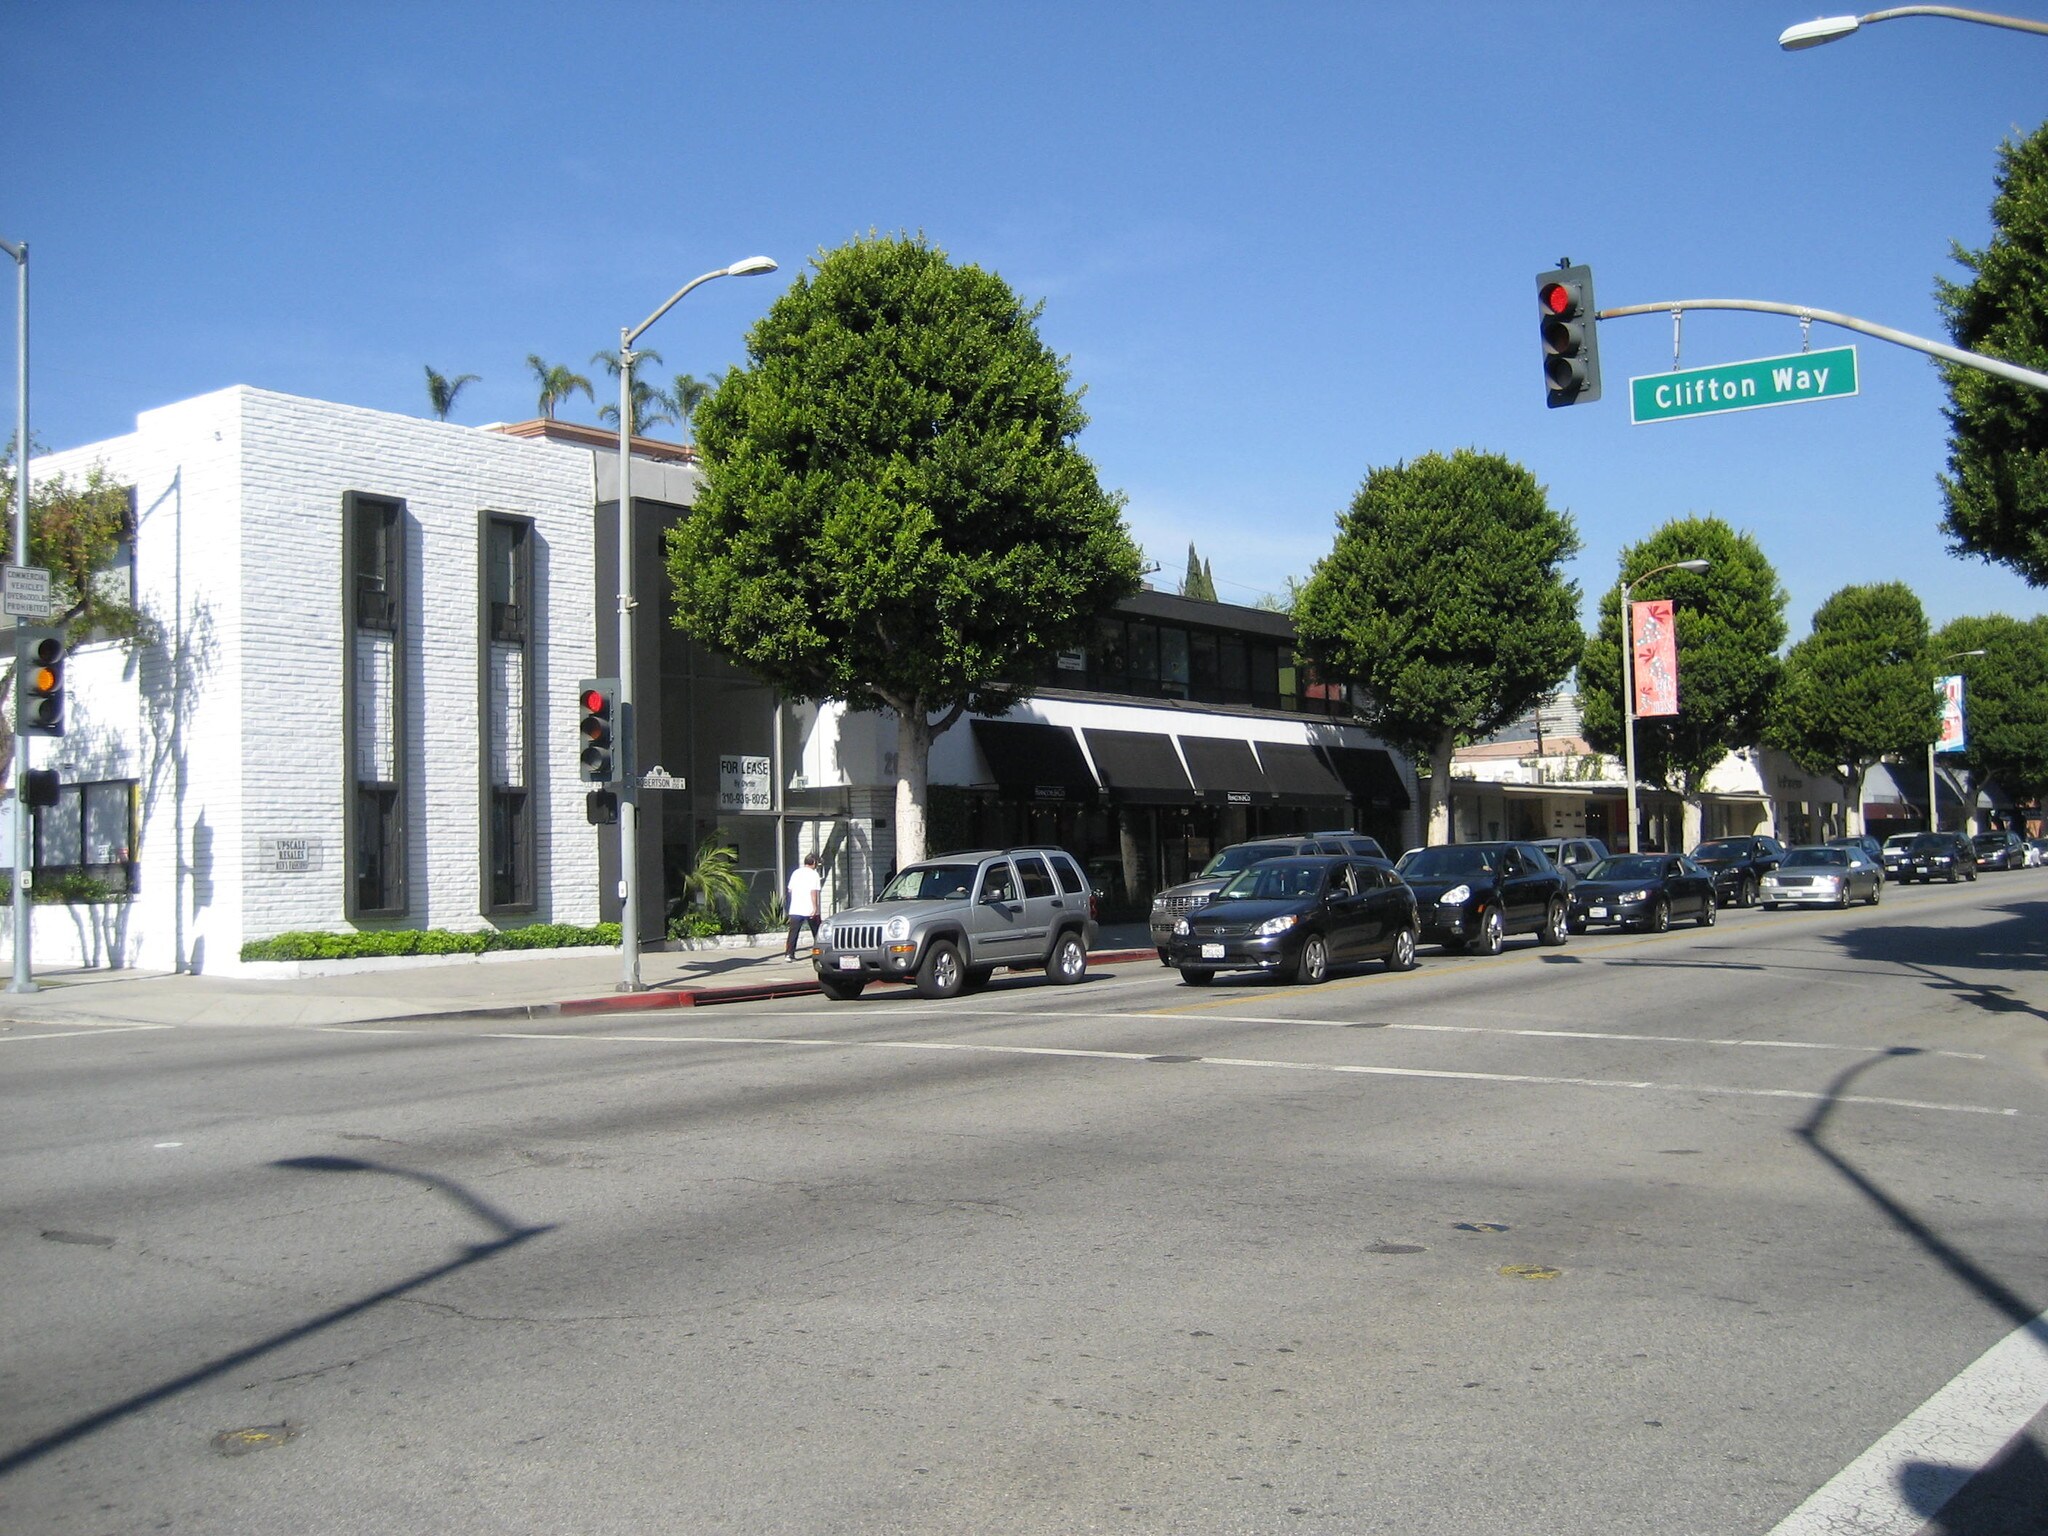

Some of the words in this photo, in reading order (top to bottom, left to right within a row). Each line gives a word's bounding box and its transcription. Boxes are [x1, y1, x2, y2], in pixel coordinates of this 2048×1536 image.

[1655, 377, 1755, 408] Clifton
[1772, 367, 1829, 394] Way
[7, 571, 48, 581] COMMERCIAL
[12, 582, 44, 592] VEHICLES
[7, 602, 48, 613] PROHIBITED
[721, 761, 738, 774] FOR
[741, 762, 769, 775] LEASE
[276, 840, 306, 850] UPSCALE
[279, 850, 304, 860] RESALES
